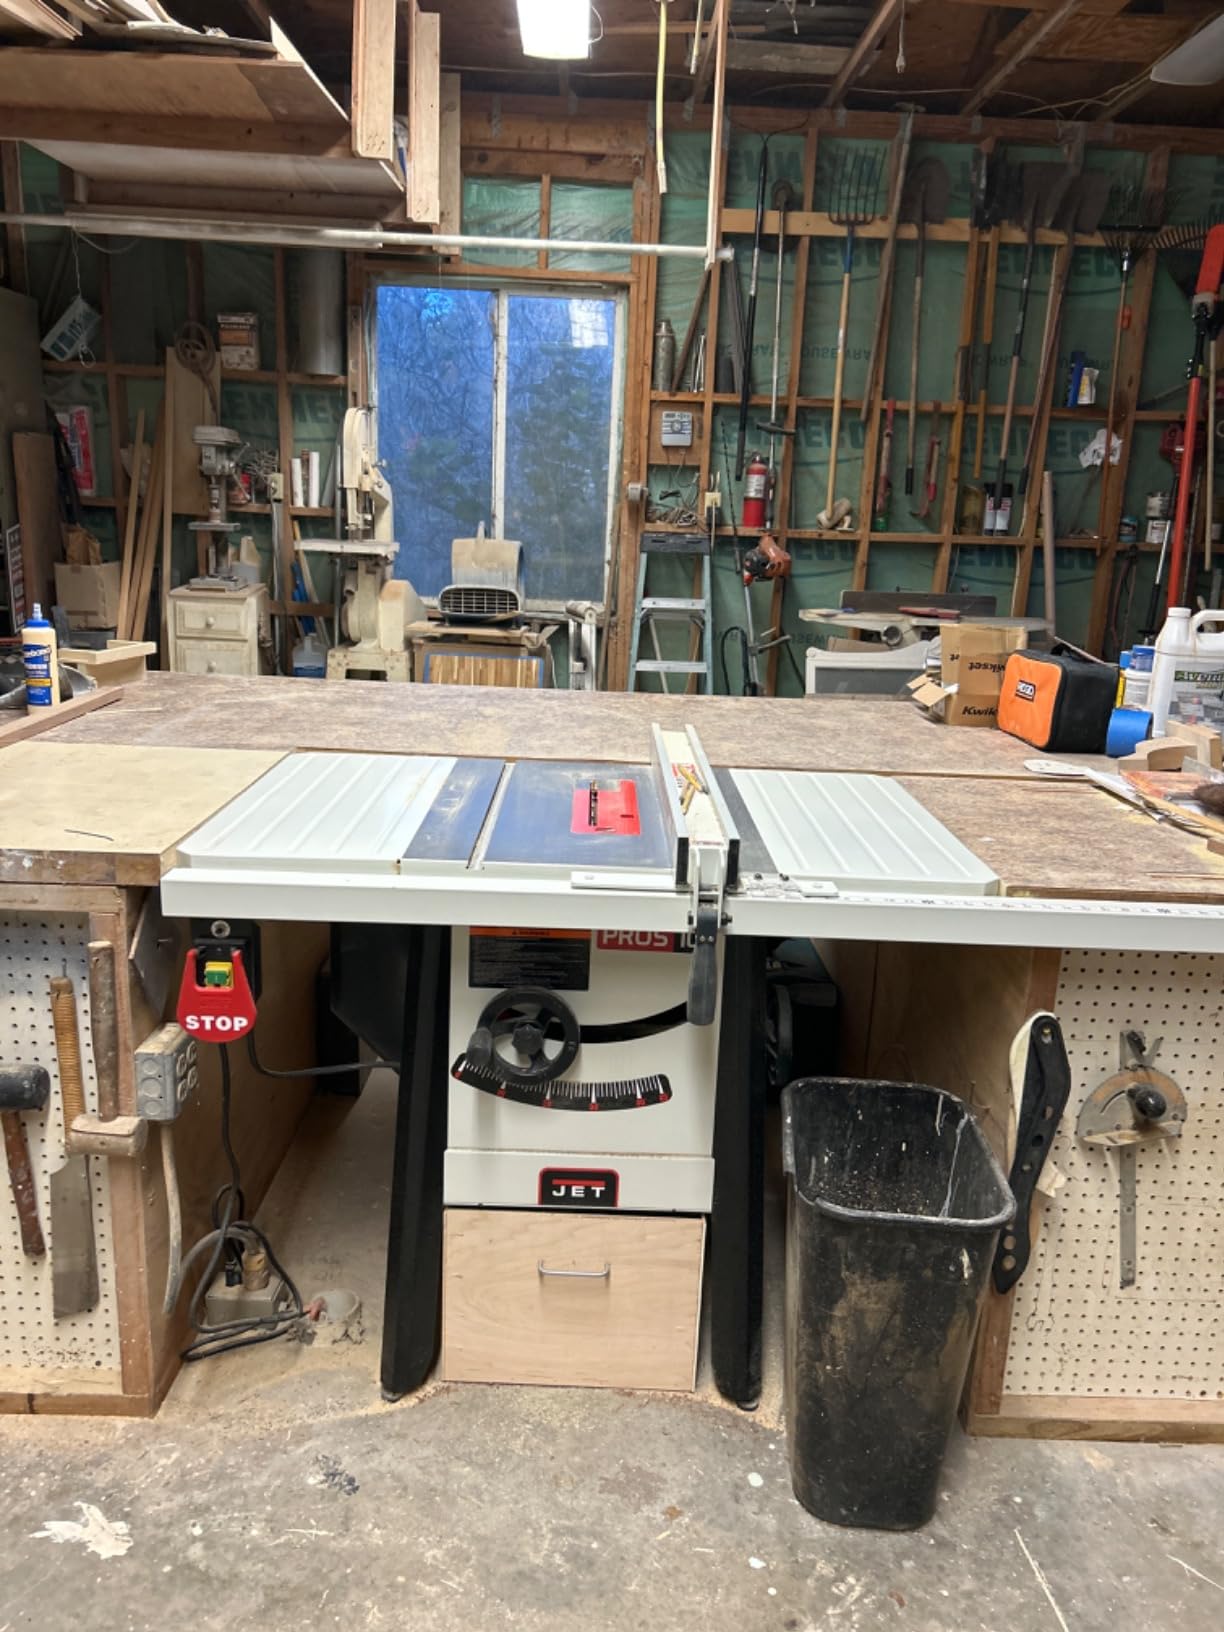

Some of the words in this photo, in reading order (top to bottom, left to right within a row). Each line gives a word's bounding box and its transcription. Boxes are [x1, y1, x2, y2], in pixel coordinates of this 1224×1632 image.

[962, 705, 998, 716] Kwik
[602, 929, 669, 947] PROS
[185, 1015, 248, 1031] STOP
[551, 1185, 606, 1198] JET
